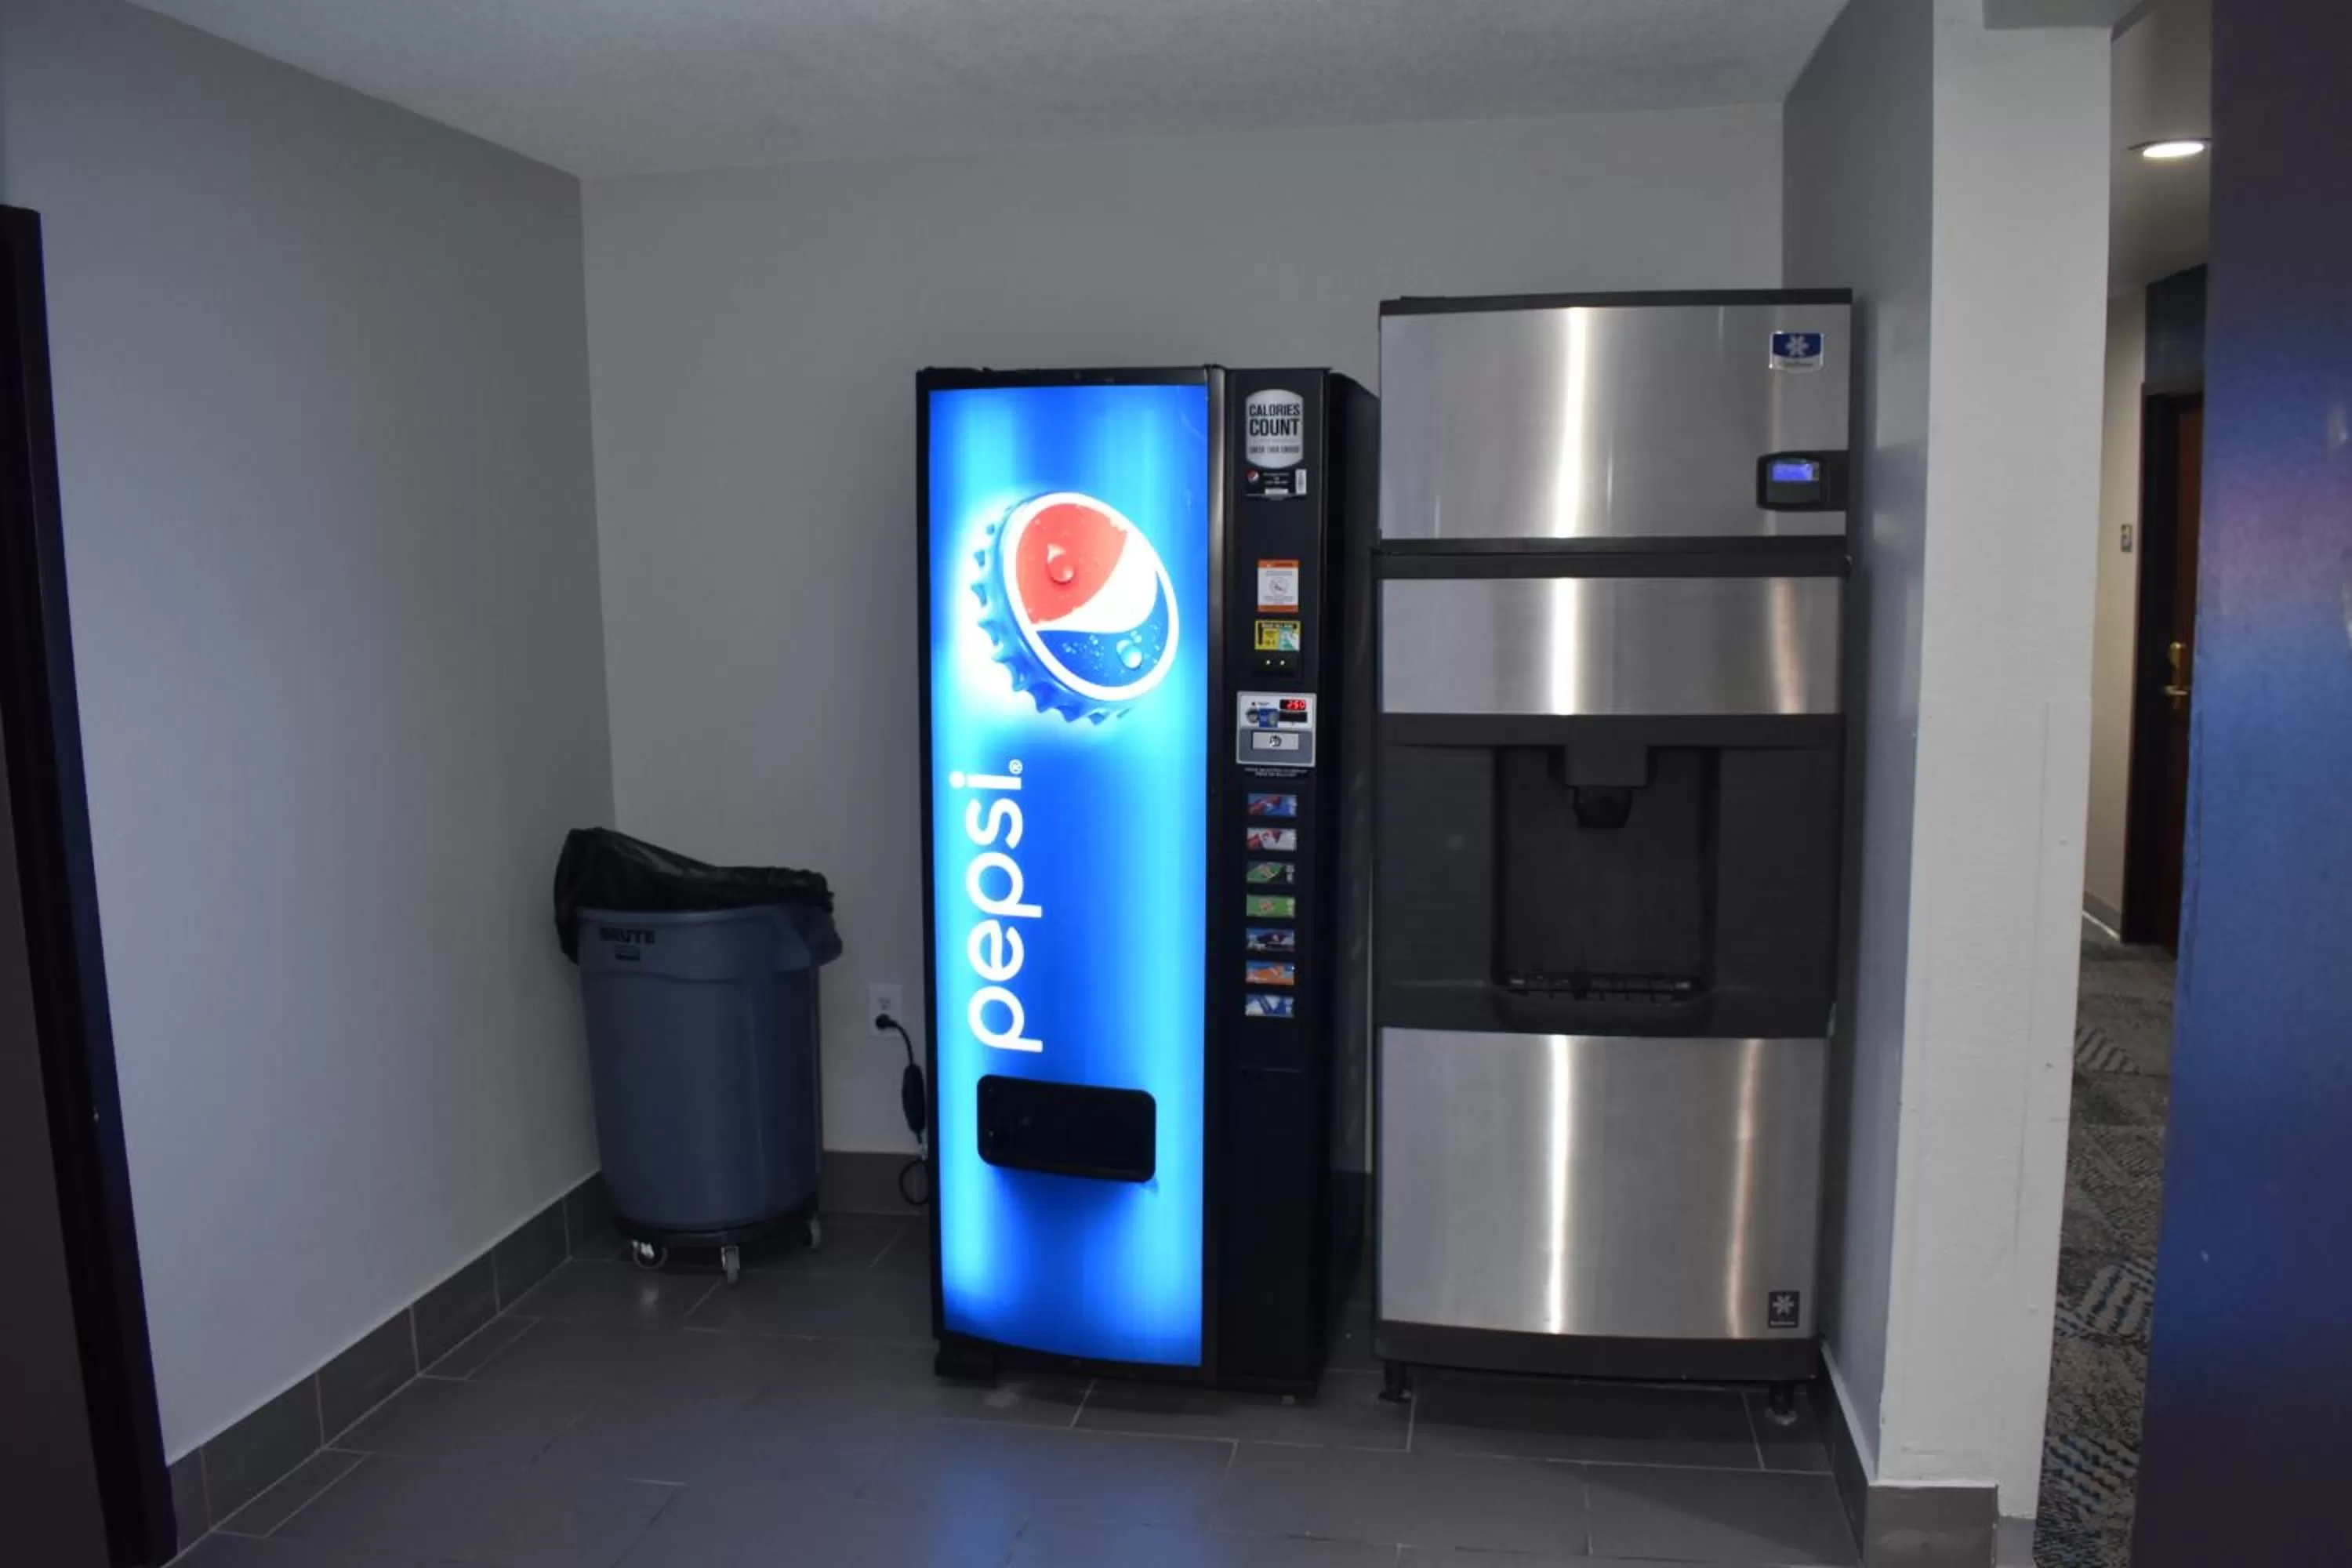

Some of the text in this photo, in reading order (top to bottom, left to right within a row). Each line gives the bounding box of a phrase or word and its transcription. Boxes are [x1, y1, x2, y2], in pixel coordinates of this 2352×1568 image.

[1249, 404, 1301, 416] CALORIES
[1249, 418, 1300, 436] COUNT
[949, 768, 1043, 1052] pepsi
